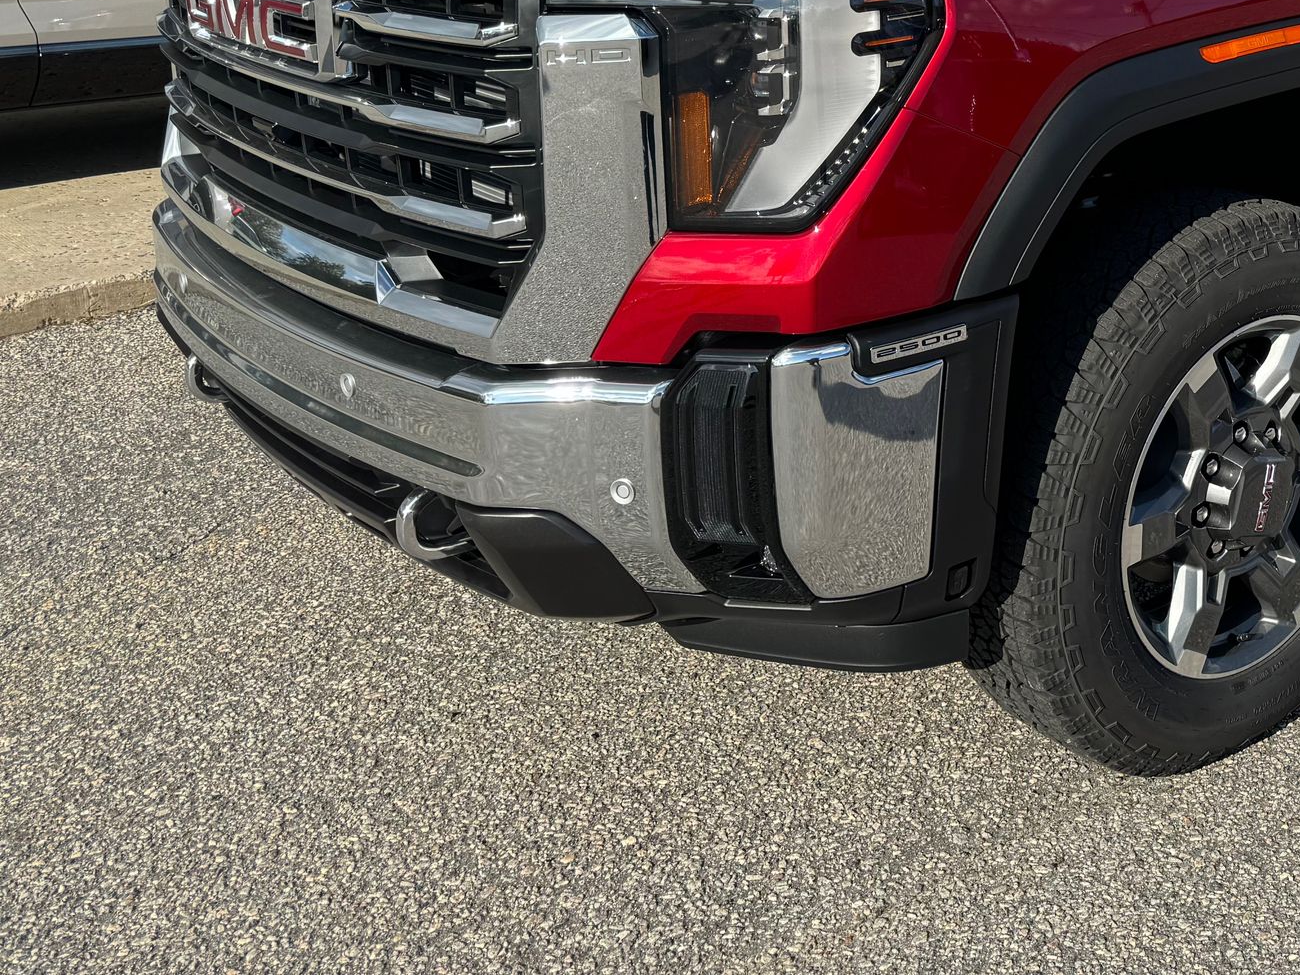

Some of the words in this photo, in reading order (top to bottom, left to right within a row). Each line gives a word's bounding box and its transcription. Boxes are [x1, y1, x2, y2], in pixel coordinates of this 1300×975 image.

[546, 47, 632, 66] HD
[876, 329, 962, 359] 2500
[1253, 462, 1277, 534] GMC
